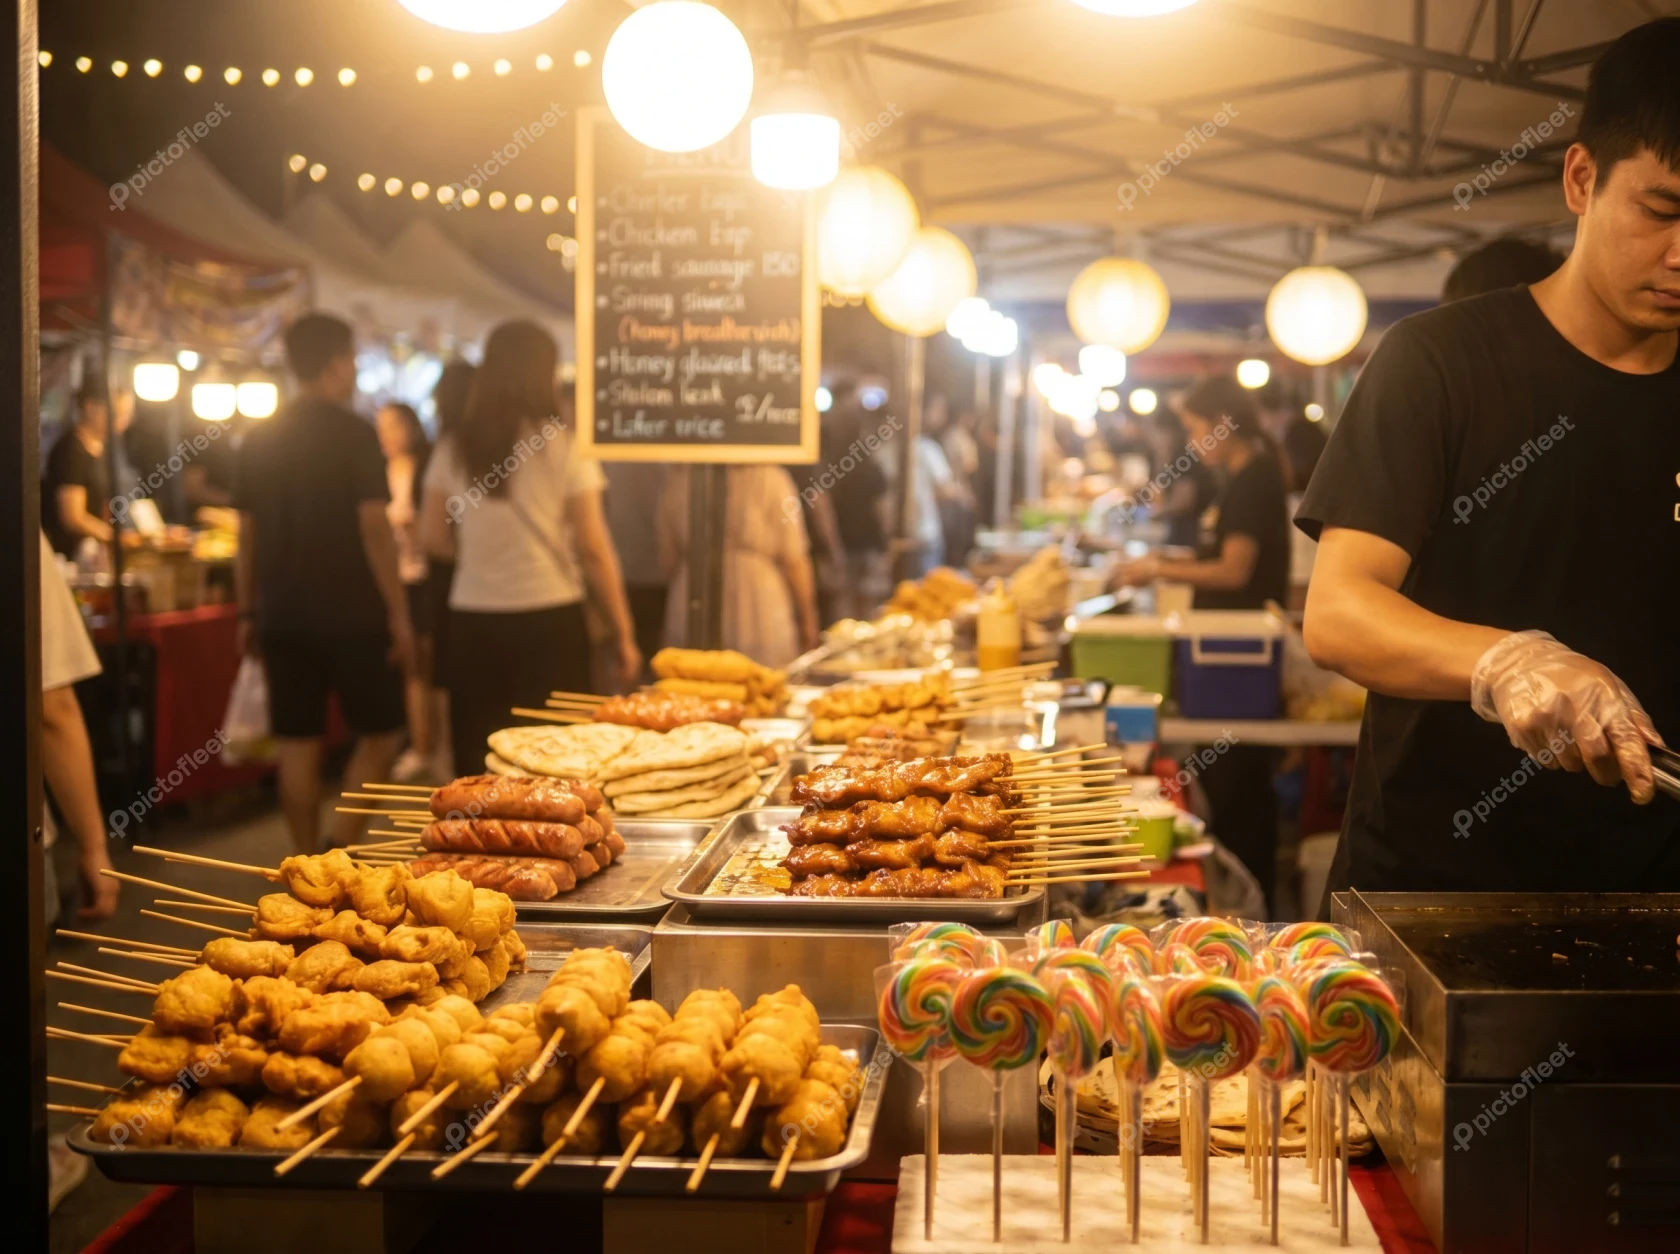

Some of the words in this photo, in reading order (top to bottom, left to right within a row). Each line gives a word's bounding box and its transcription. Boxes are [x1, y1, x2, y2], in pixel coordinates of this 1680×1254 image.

[607, 216, 697, 247] Chicken
[610, 252, 663, 279] Fried
[610, 346, 675, 383] Honey
